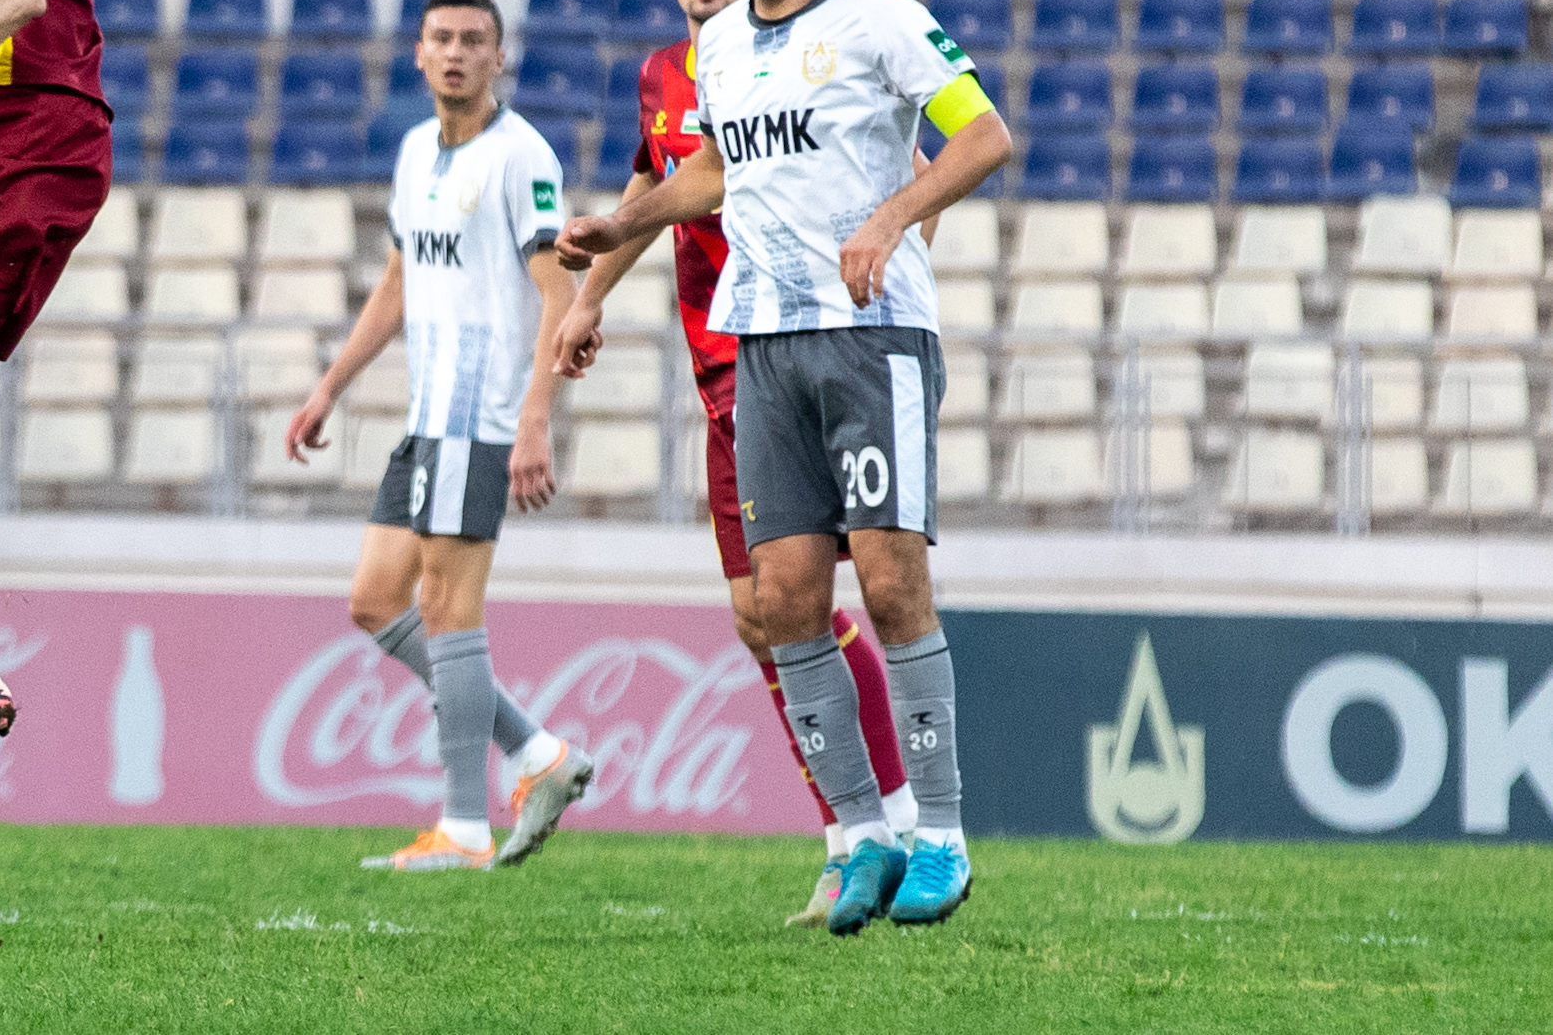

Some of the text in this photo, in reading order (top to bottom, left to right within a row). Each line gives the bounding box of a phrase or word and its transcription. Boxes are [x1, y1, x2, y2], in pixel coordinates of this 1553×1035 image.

[722, 108, 820, 164] OKMK
[412, 229, 463, 268] KMK
[842, 445, 889, 509] 20
[800, 731, 825, 755] 20
[909, 729, 937, 751] 20
